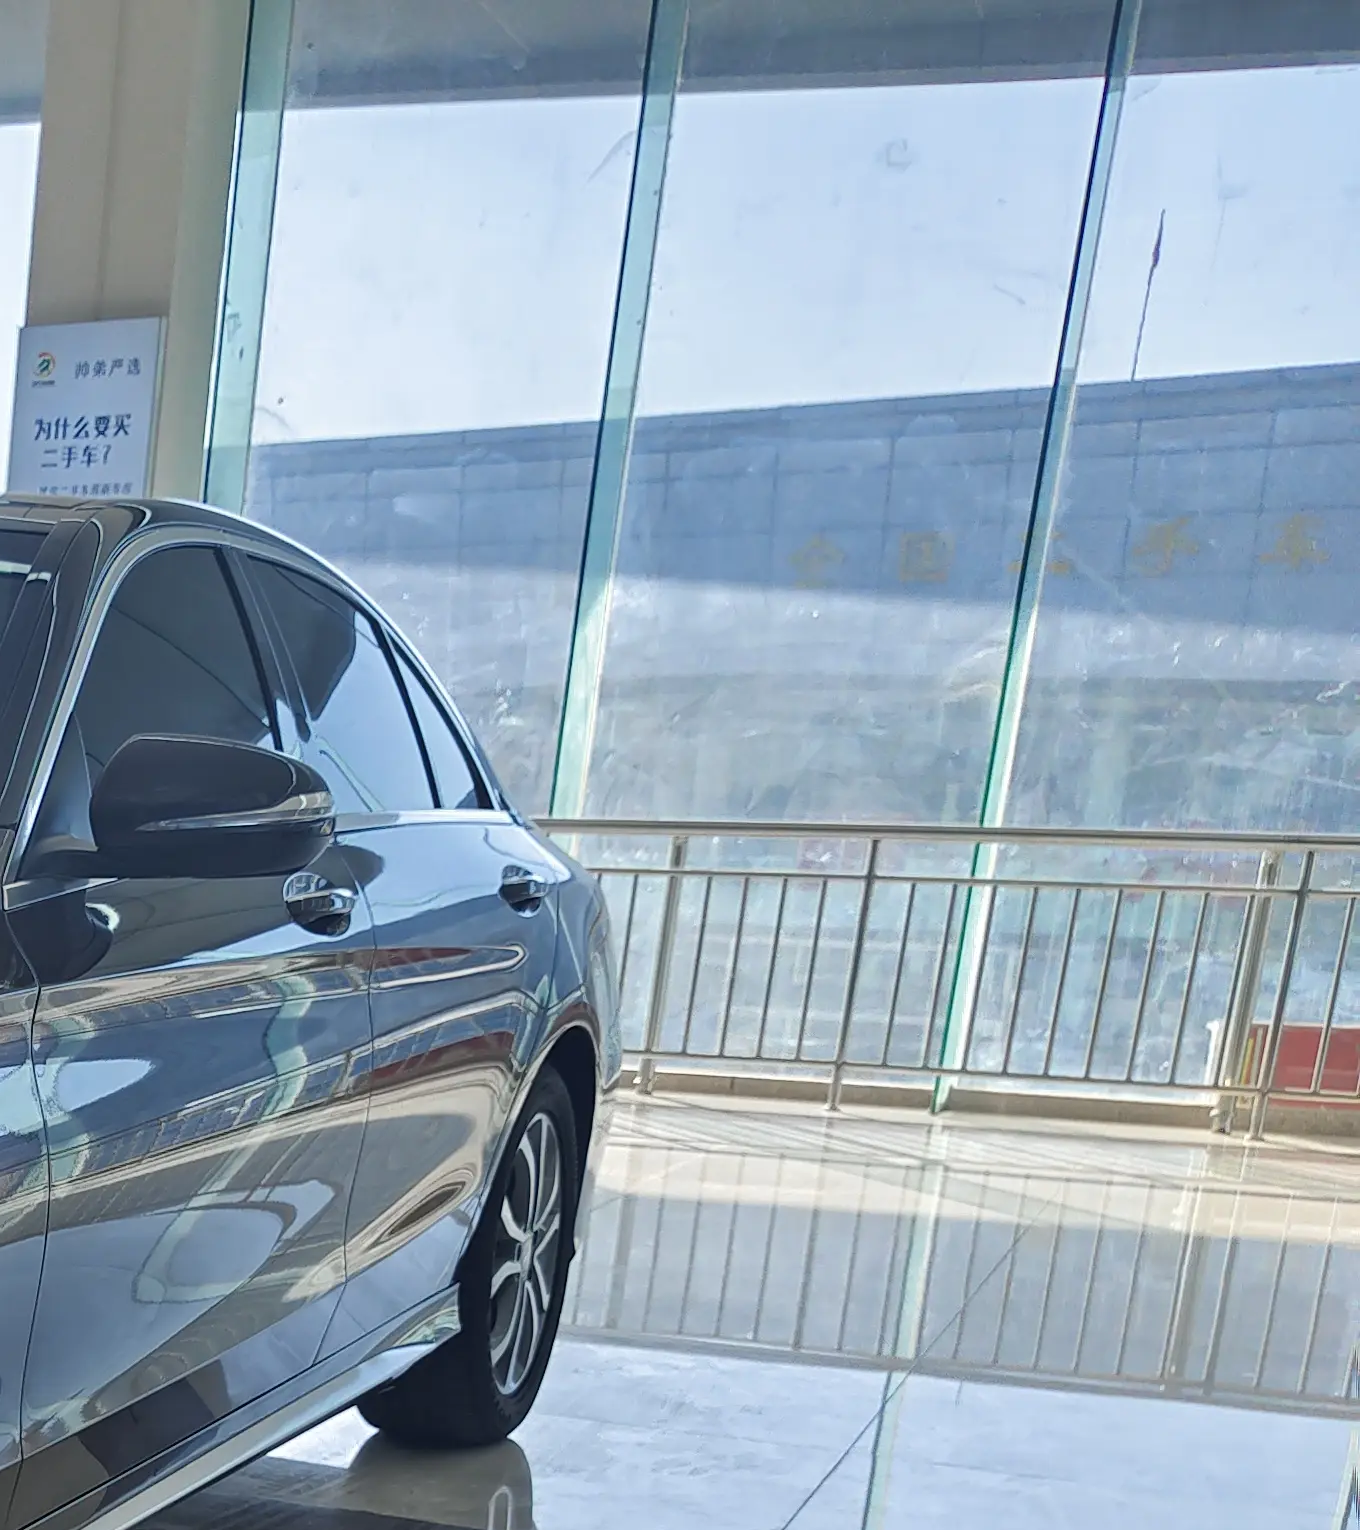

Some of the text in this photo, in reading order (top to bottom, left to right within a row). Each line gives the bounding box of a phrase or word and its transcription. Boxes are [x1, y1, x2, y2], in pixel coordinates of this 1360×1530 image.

[34, 413, 132, 441] 为什么要买
[41, 444, 112, 469] 二手车？
